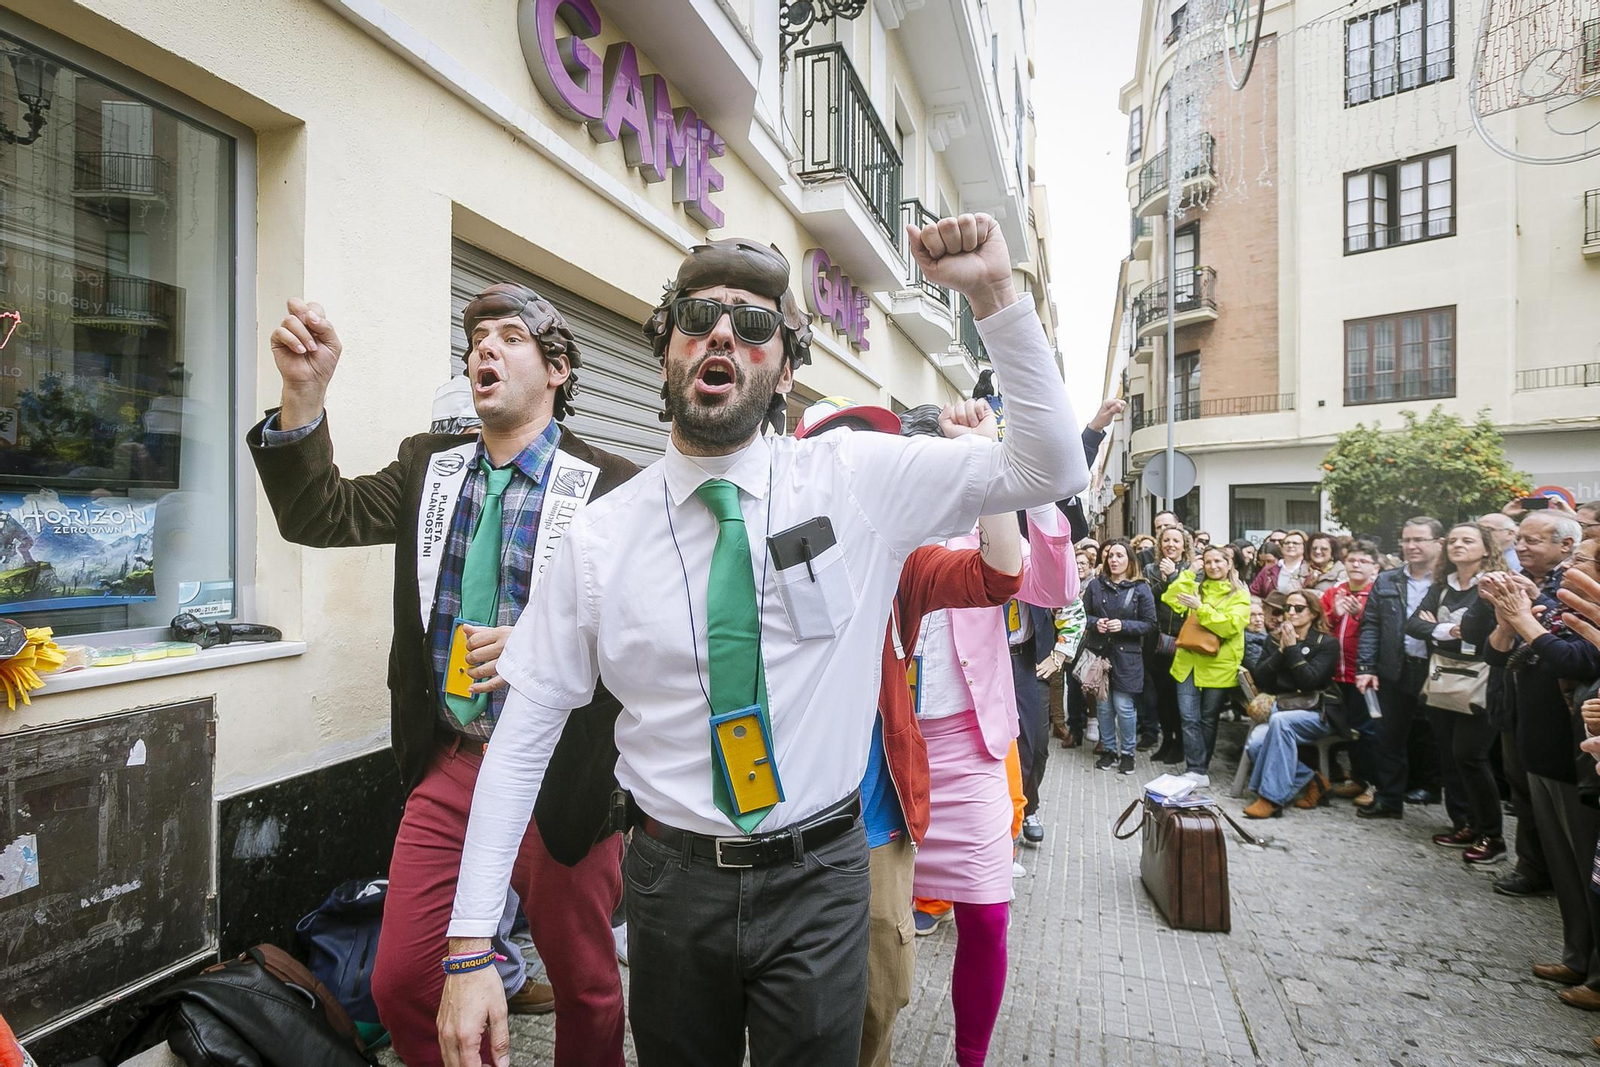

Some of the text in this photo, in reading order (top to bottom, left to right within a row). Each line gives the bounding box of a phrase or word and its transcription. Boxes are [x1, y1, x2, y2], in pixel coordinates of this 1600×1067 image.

[518, 0, 726, 229] GAME
[36, 287, 89, 310] 500GB
[802, 248, 870, 351] GAME
[53, 526, 122, 534] ZERO DAWN
[434, 494, 448, 542] PLANETA
[544, 500, 561, 530] ediciones
